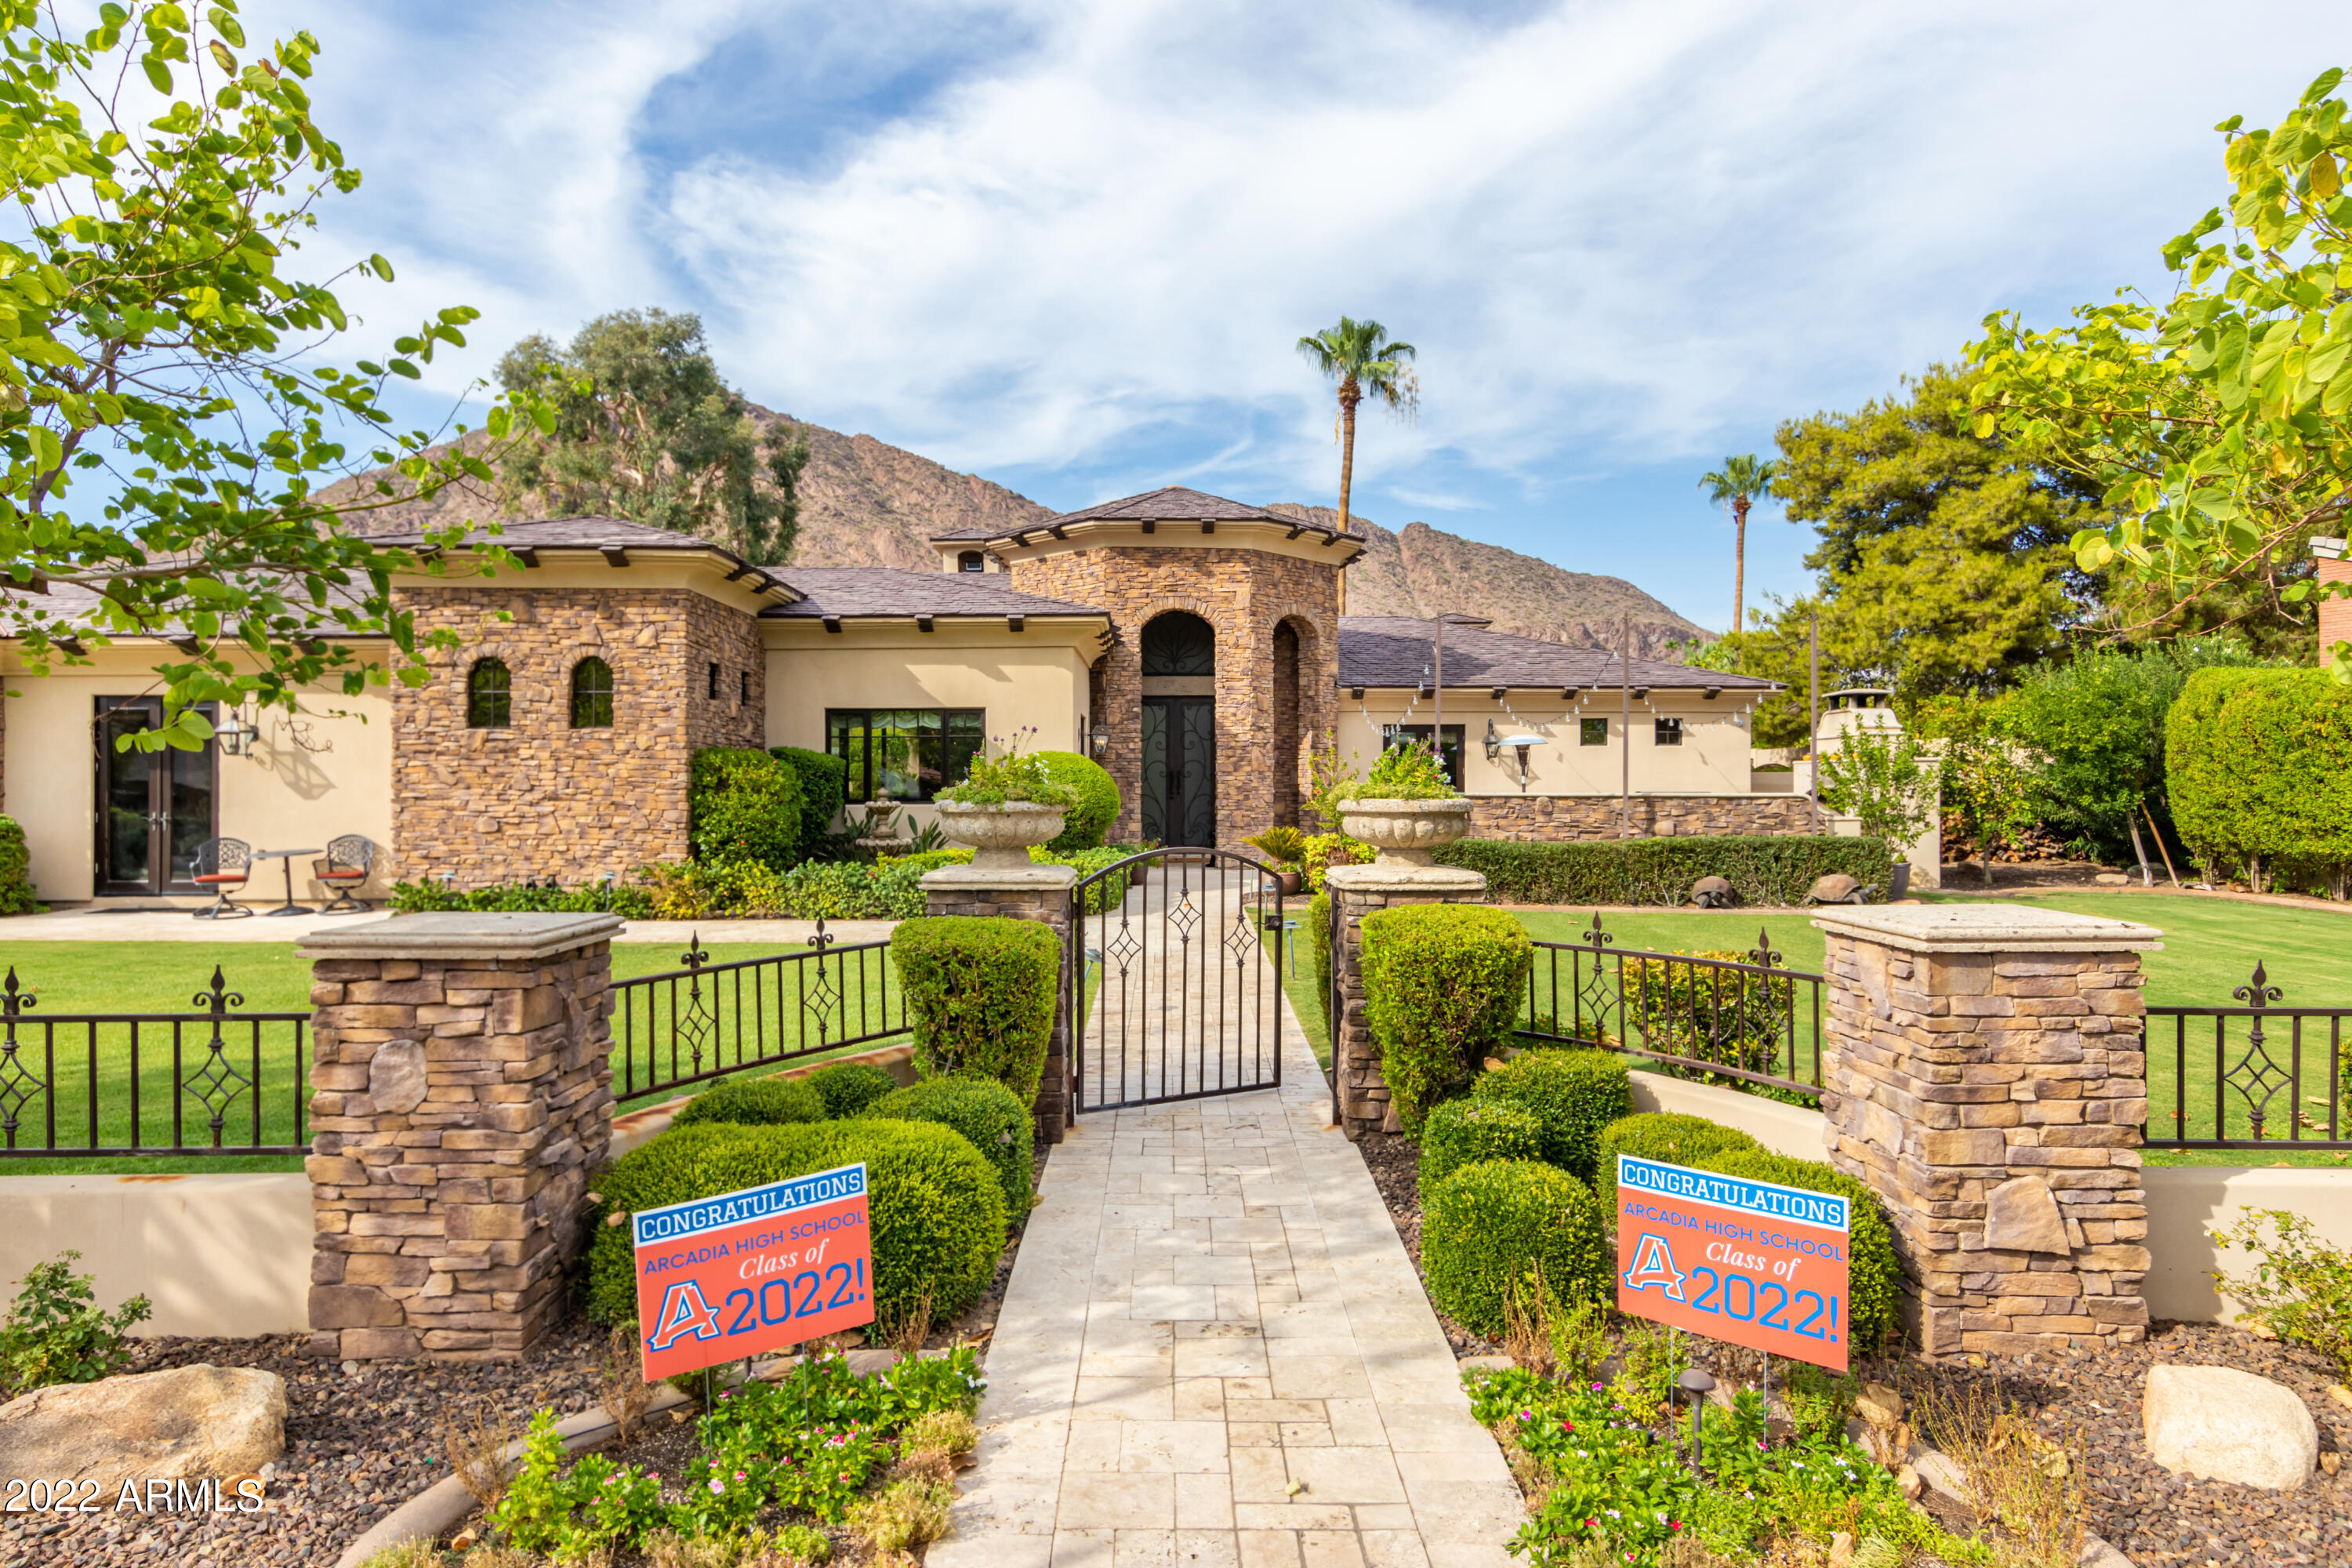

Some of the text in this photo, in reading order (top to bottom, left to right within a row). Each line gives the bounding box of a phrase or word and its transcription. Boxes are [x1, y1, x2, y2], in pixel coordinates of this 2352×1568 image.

[641, 1172, 862, 1240] CONGRATULATIONS
[1624, 1164, 1842, 1224] CONGRATULATIONS
[644, 1210, 865, 1275] ARCADIA HIGH SCHOOL
[739, 1238, 830, 1279] Class of
[1624, 1202, 1844, 1261] ARCADIA HIGH SCHOOL
[1706, 1242, 1802, 1282] Class of
[725, 1258, 865, 1336] 2022!
[1622, 1232, 1687, 1303] A
[645, 1279, 722, 1352] A
[1691, 1265, 1838, 1343] 2022!
